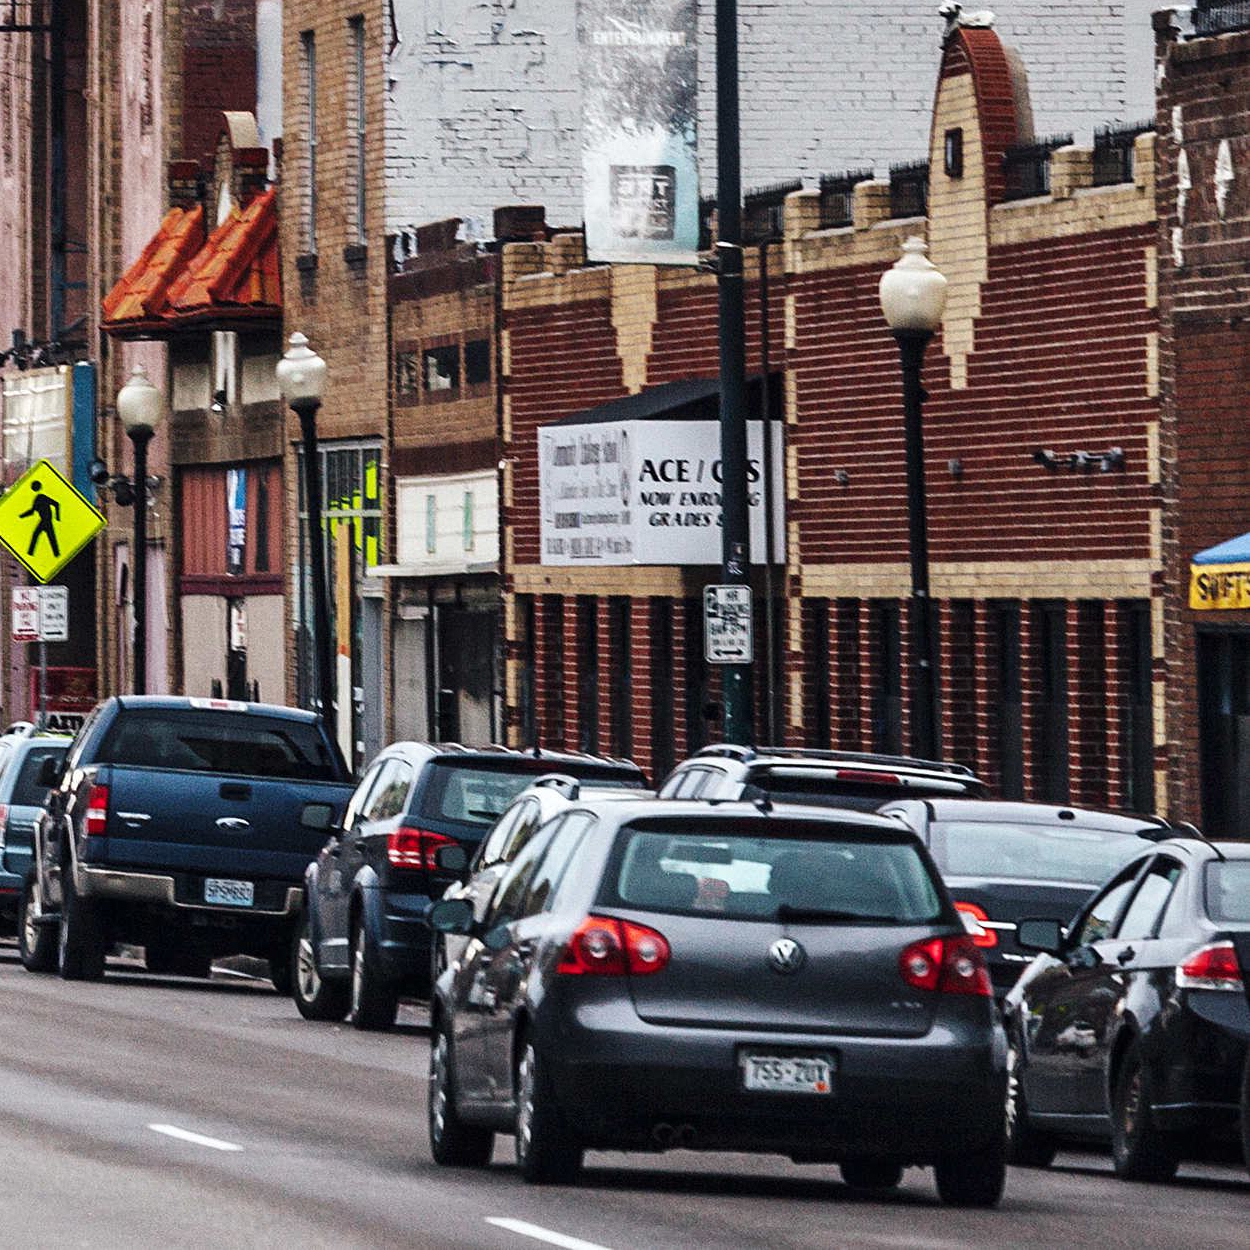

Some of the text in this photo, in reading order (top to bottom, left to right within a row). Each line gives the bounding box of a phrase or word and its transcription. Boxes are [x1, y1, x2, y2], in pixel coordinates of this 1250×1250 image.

[639, 459, 690, 483] ACE
[711, 459, 760, 483] CS
[639, 491, 761, 506] NOW ENROG
[649, 512, 712, 527] GRADES
